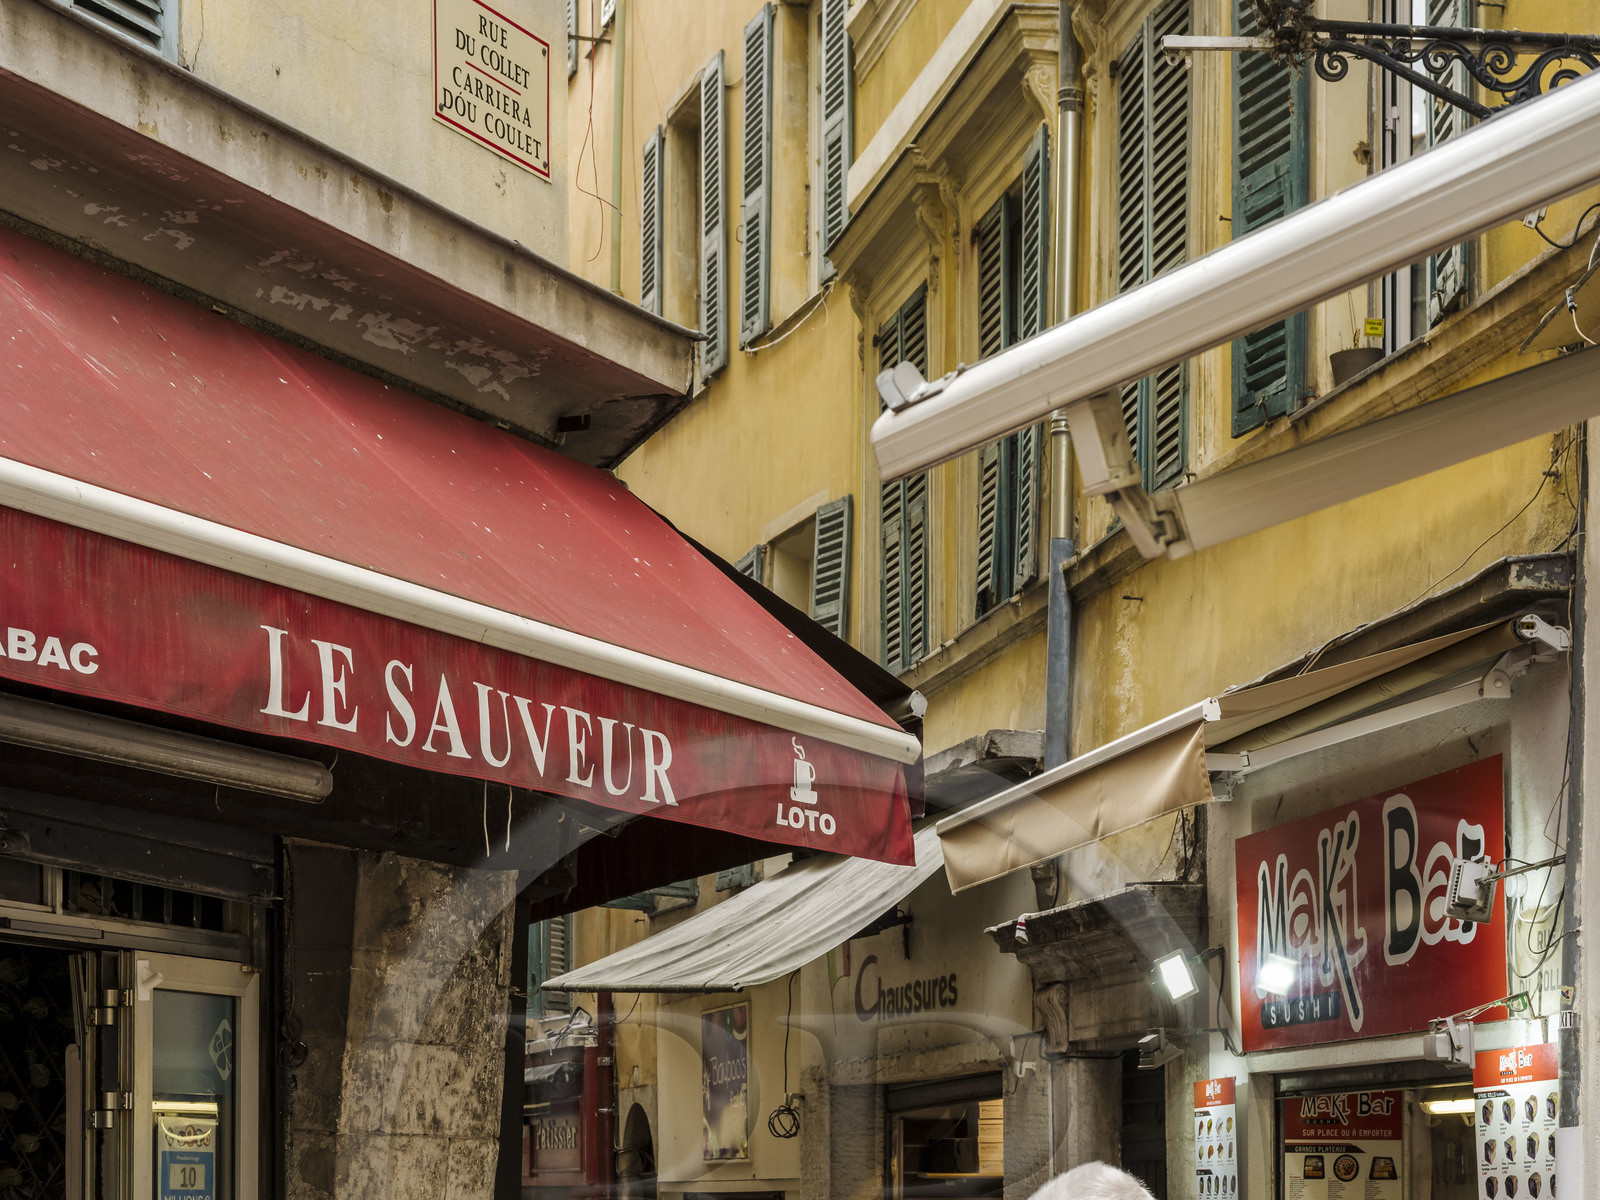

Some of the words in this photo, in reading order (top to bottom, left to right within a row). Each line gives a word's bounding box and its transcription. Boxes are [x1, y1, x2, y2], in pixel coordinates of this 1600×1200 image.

[479, 14, 508, 49] RUE
[455, 28, 475, 56] DU
[480, 44, 530, 89] COLLET
[452, 66, 532, 128] CARRIERA
[484, 112, 541, 160] COULET
[260, 624, 358, 733] LE
[384, 659, 679, 806] SAUVEUR
[776, 802, 837, 836] LOTO
[854, 954, 958, 1022] Chaussures
[1270, 996, 1332, 1025] SUSHI
[1357, 1092, 1394, 1116] Bar
[1302, 1129, 1315, 1137] SUR
[1359, 1129, 1392, 1137] EMPORTER
[180, 1166, 197, 1188] 10
